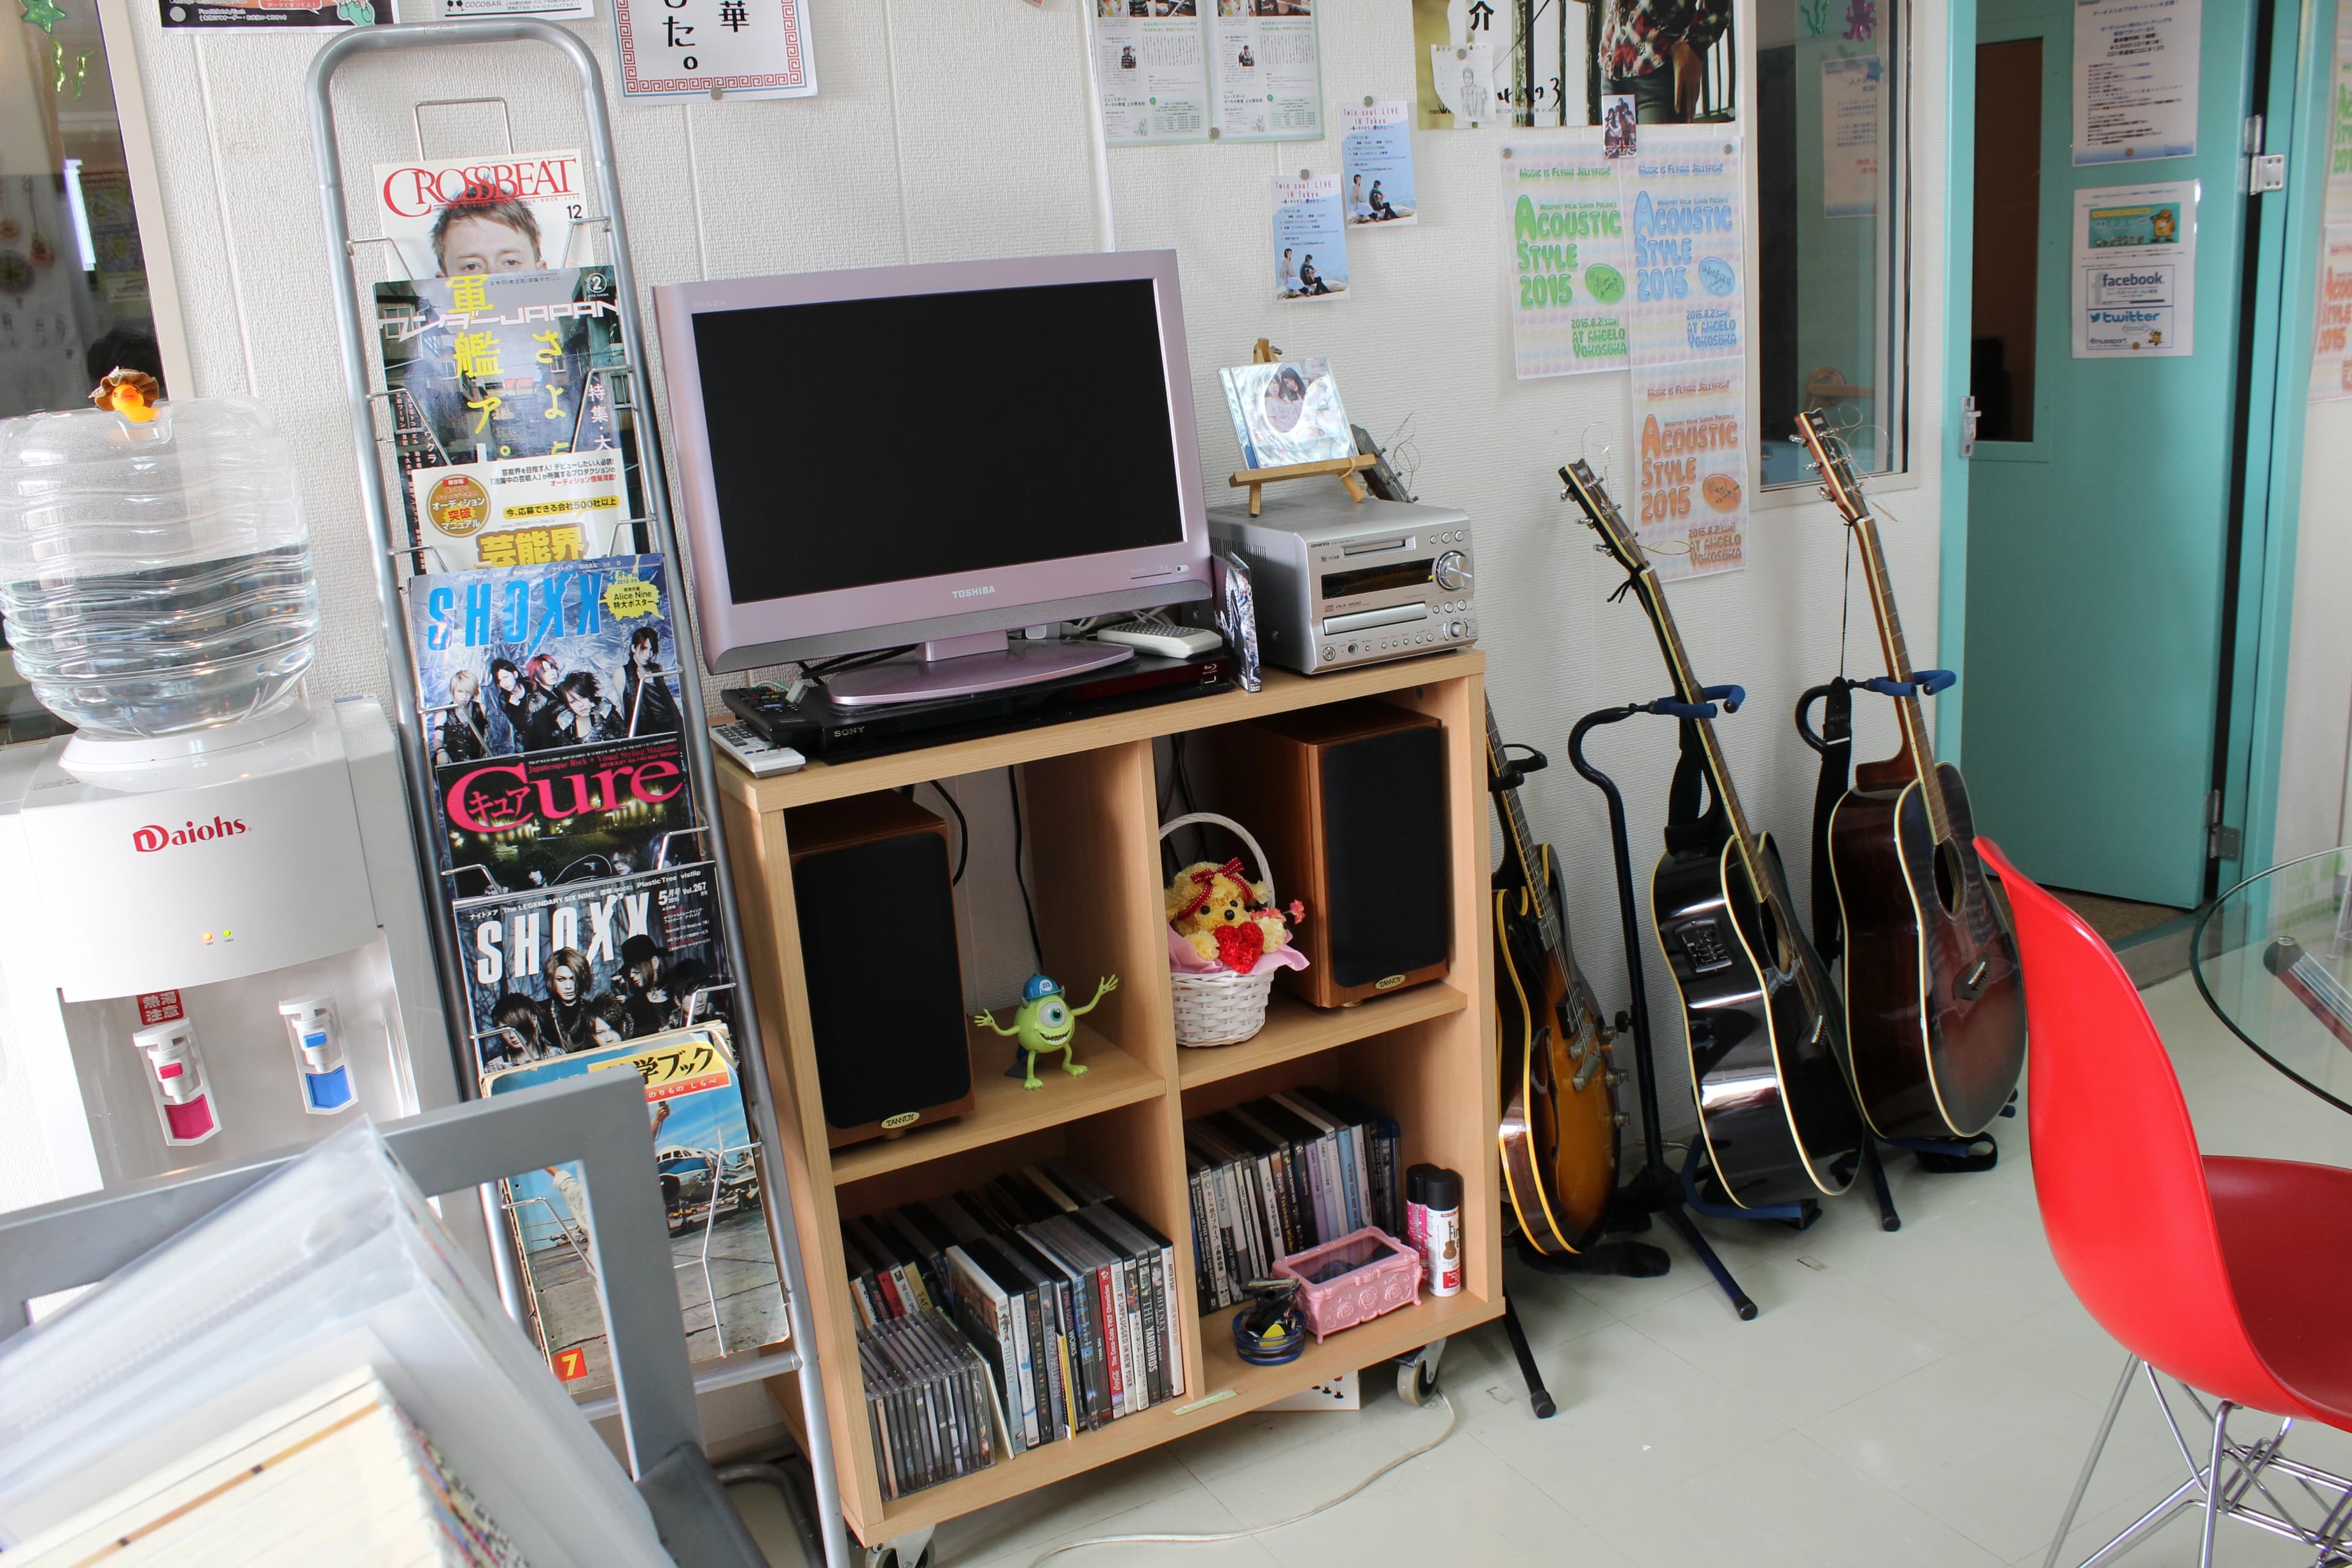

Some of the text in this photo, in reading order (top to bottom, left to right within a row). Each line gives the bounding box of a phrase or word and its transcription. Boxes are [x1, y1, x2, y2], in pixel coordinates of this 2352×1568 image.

[718, 1, 750, 32] 華
[1468, 1, 1495, 31] 介
[1382, 107, 1400, 115] LIVE
[383, 157, 577, 217] CROSSBEAT
[1298, 190, 1319, 198] Tokyo
[1314, 180, 1333, 189] LIVE
[567, 205, 582, 220] 12
[1520, 274, 1573, 306] 2015
[1637, 267, 1688, 301] 2015
[2102, 272, 2163, 287] facebook
[2103, 311, 2161, 323] twitter
[432, 497, 485, 511] オーディション
[506, 497, 617, 518] 今、応募できる会社500社以上
[1641, 486, 1691, 521] 2015
[441, 519, 481, 530] マニュアル
[448, 508, 472, 522] 突破
[478, 526, 585, 567] 芸能界
[614, 590, 652, 601] Alice Nine
[951, 585, 996, 598] TOSHIBA
[428, 571, 603, 655] SHOXX
[612, 598, 654, 610] 特大ポスター
[834, 725, 866, 737] SONY
[447, 760, 685, 833] Cure
[468, 786, 532, 823] キュア
[132, 815, 247, 853] Daiohs
[469, 909, 499, 921] ナイトメア
[502, 906, 517, 914] The
[518, 897, 564, 911] LEGENDARY
[578, 891, 597, 900] NINE
[636, 878, 662, 889] Plastic
[680, 870, 701, 879] vistlip
[682, 881, 707, 895] Vol.267
[477, 892, 650, 985] SHOXX
[1378, 976, 1404, 988] TANNOY
[142, 990, 177, 1009] 熱湯
[146, 1005, 180, 1023] 注意
[648, 1077, 717, 1099] のりもの しらべ
[886, 1114, 916, 1127] TANNOY
[1214, 1177, 1224, 1198] Bonnie
[1102, 1284, 1112, 1313] Chronicles
[1155, 1286, 1167, 1332] WHITNEY
[1065, 1308, 1073, 1330] FLOYD
[1117, 1302, 1129, 1344] UNPLUGGED
[1068, 1330, 1077, 1356] WORKS
[1107, 1327, 1117, 1356] Coca-Cola
[1142, 1298, 1159, 1373] THE YARDBIRDS
[1035, 1341, 1044, 1370] BYRDS
[1122, 1344, 1129, 1354] IN
[561, 1352, 578, 1378] 7
[1003, 1345, 1015, 1385] THIS IS IT
[1045, 1326, 1063, 1398] RANDY NEWMAN
[1124, 1369, 1133, 1389] YORK
